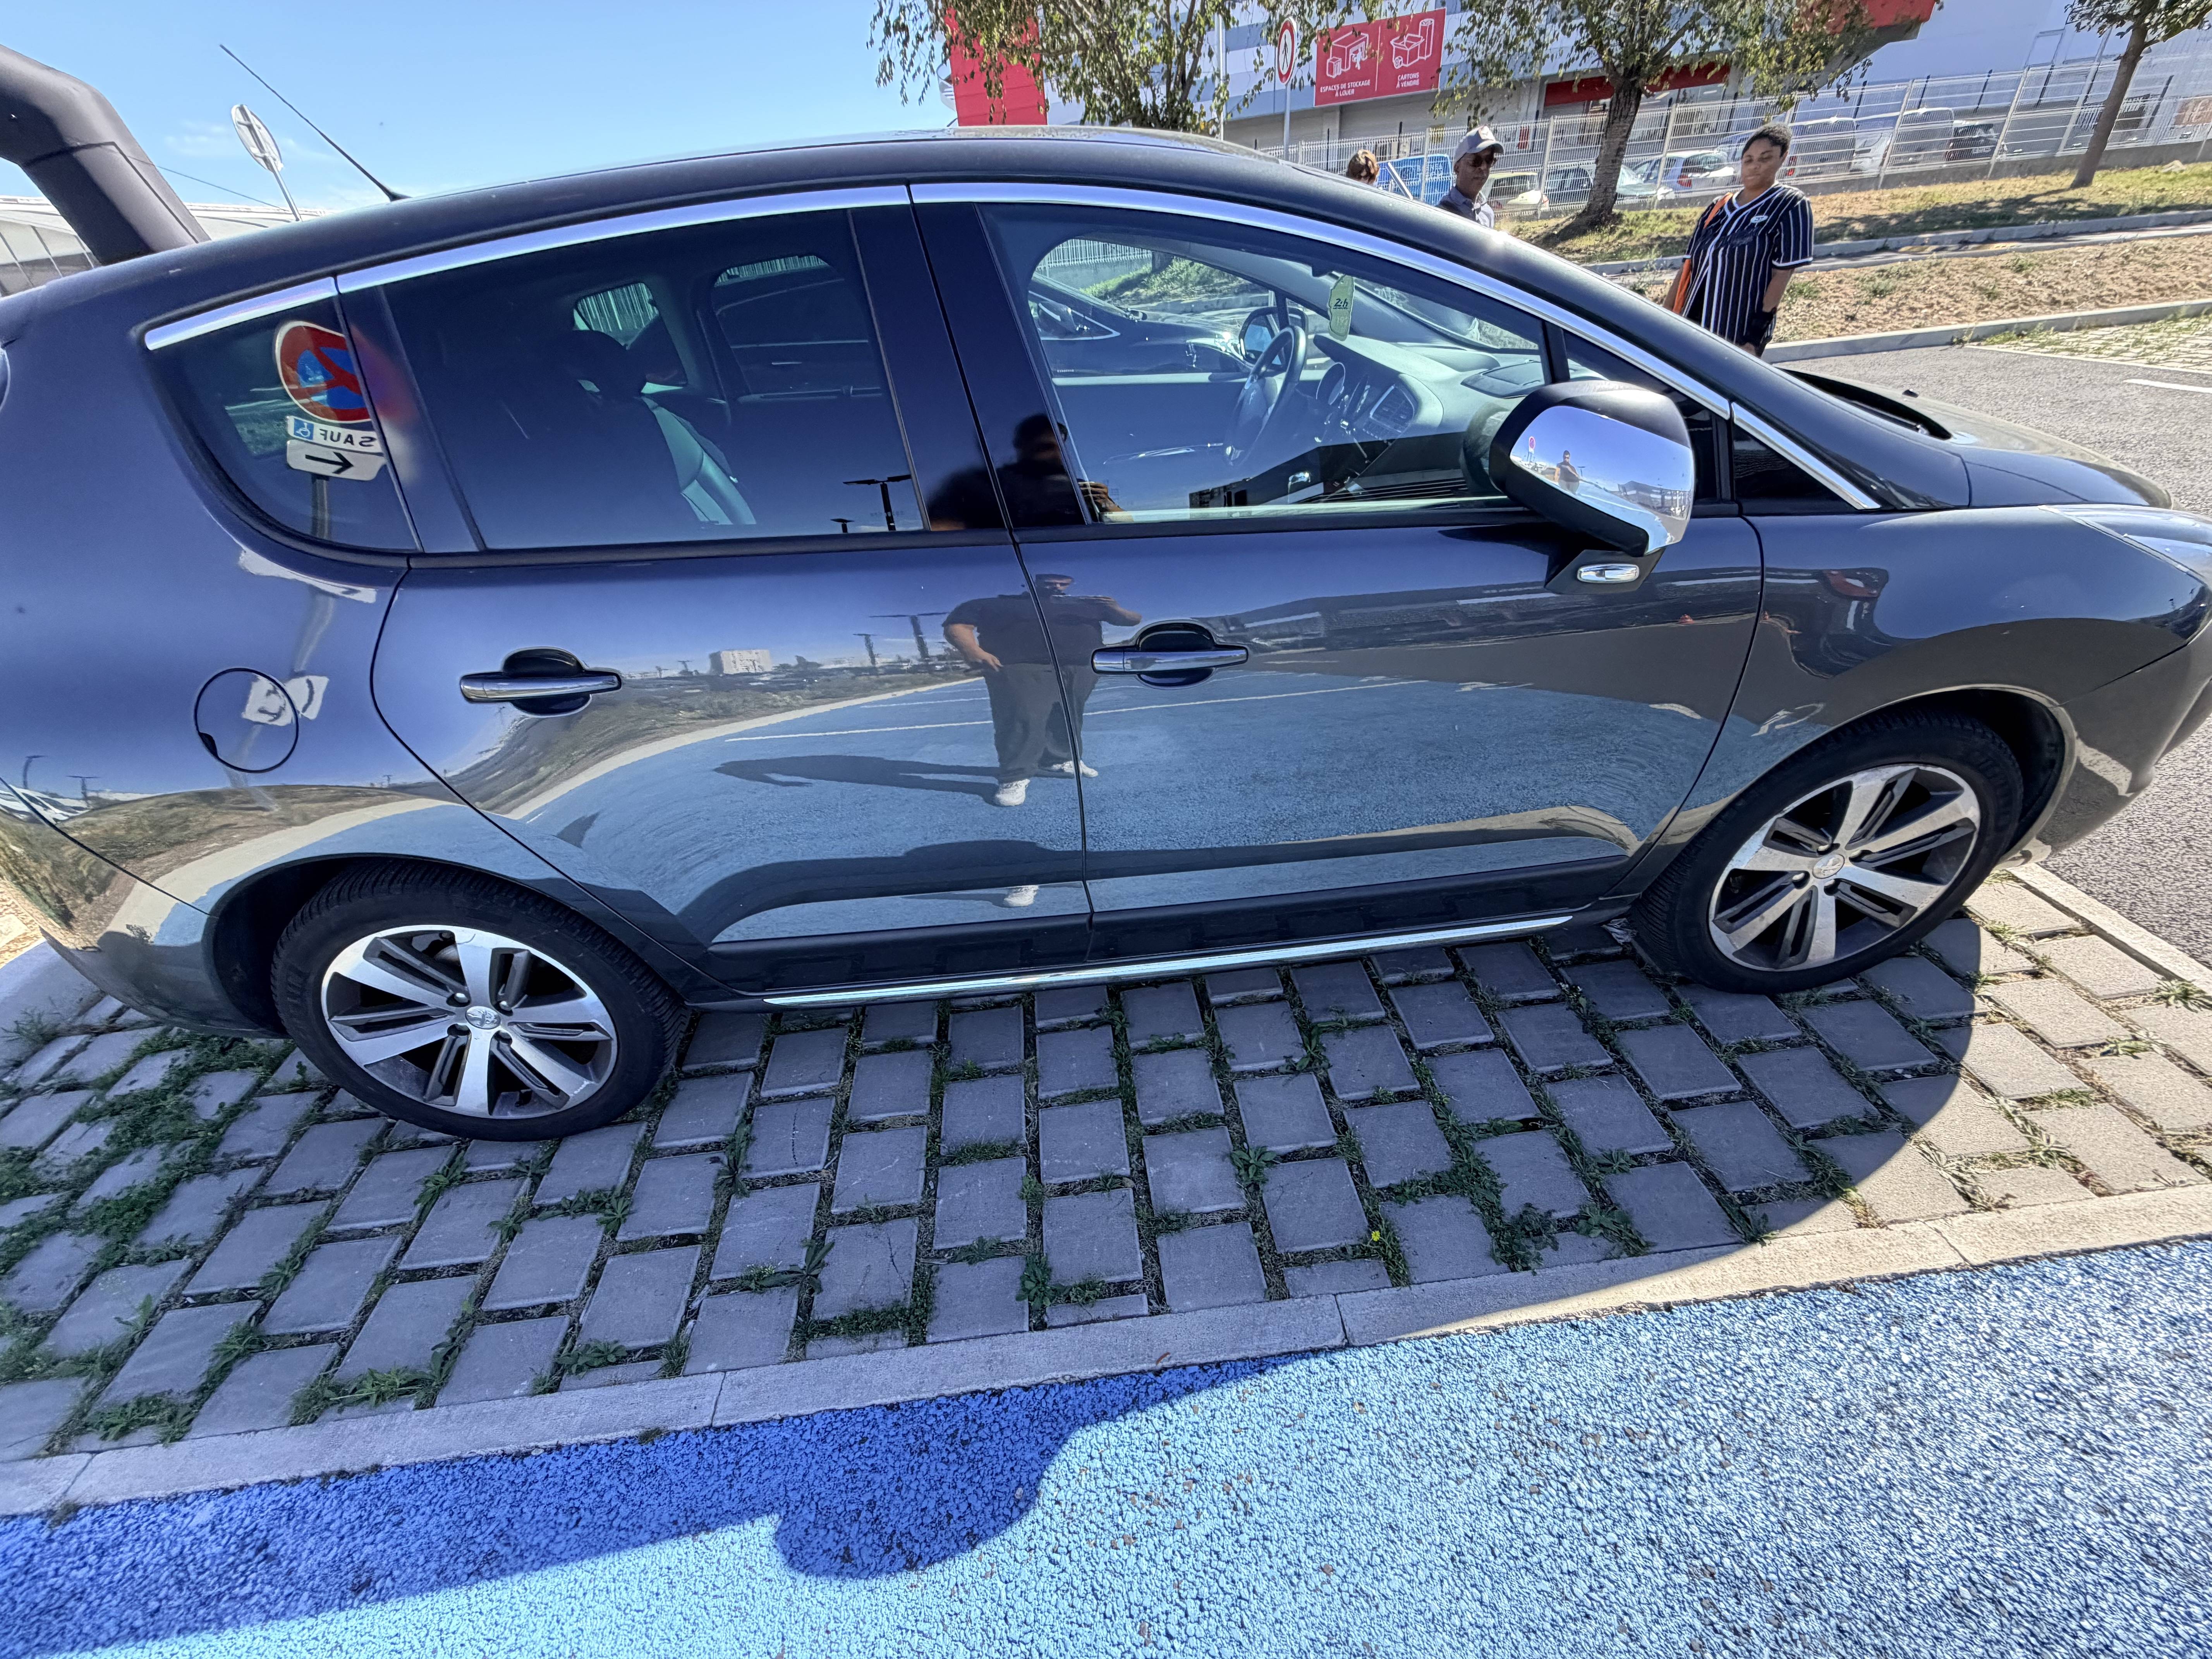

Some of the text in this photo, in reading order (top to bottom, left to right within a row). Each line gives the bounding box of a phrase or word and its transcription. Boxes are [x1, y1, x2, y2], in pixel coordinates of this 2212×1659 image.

[1398, 72, 1419, 81] CARTONS
[1320, 84, 1340, 93] ESPACES
[1347, 79, 1370, 89] STOCKAGE
[1339, 88, 1355, 96] LOUER
